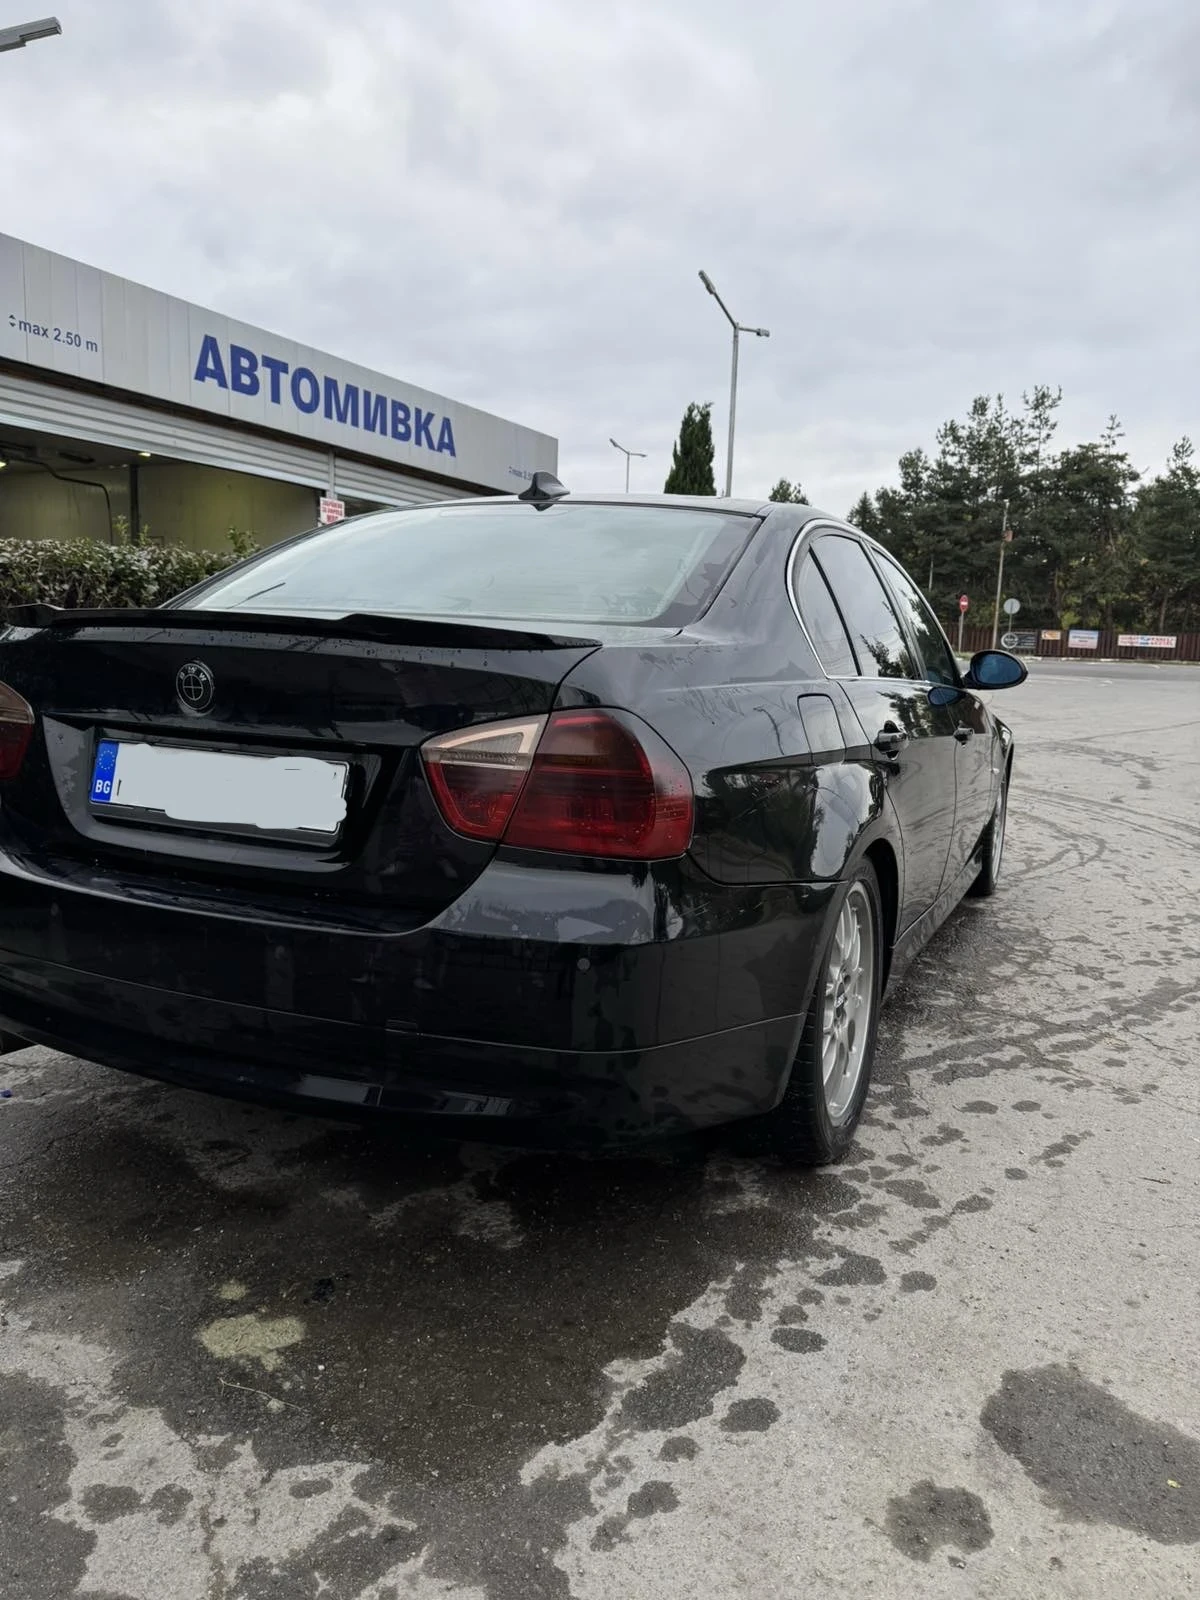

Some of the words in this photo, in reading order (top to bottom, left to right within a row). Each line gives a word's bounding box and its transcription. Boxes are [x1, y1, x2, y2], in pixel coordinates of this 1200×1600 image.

[18, 320, 49, 338] max
[53, 327, 82, 347] 2.50
[85, 340, 98, 352] m
[194, 335, 457, 458] АВТОМИВКА
[95, 779, 111, 794] BG
